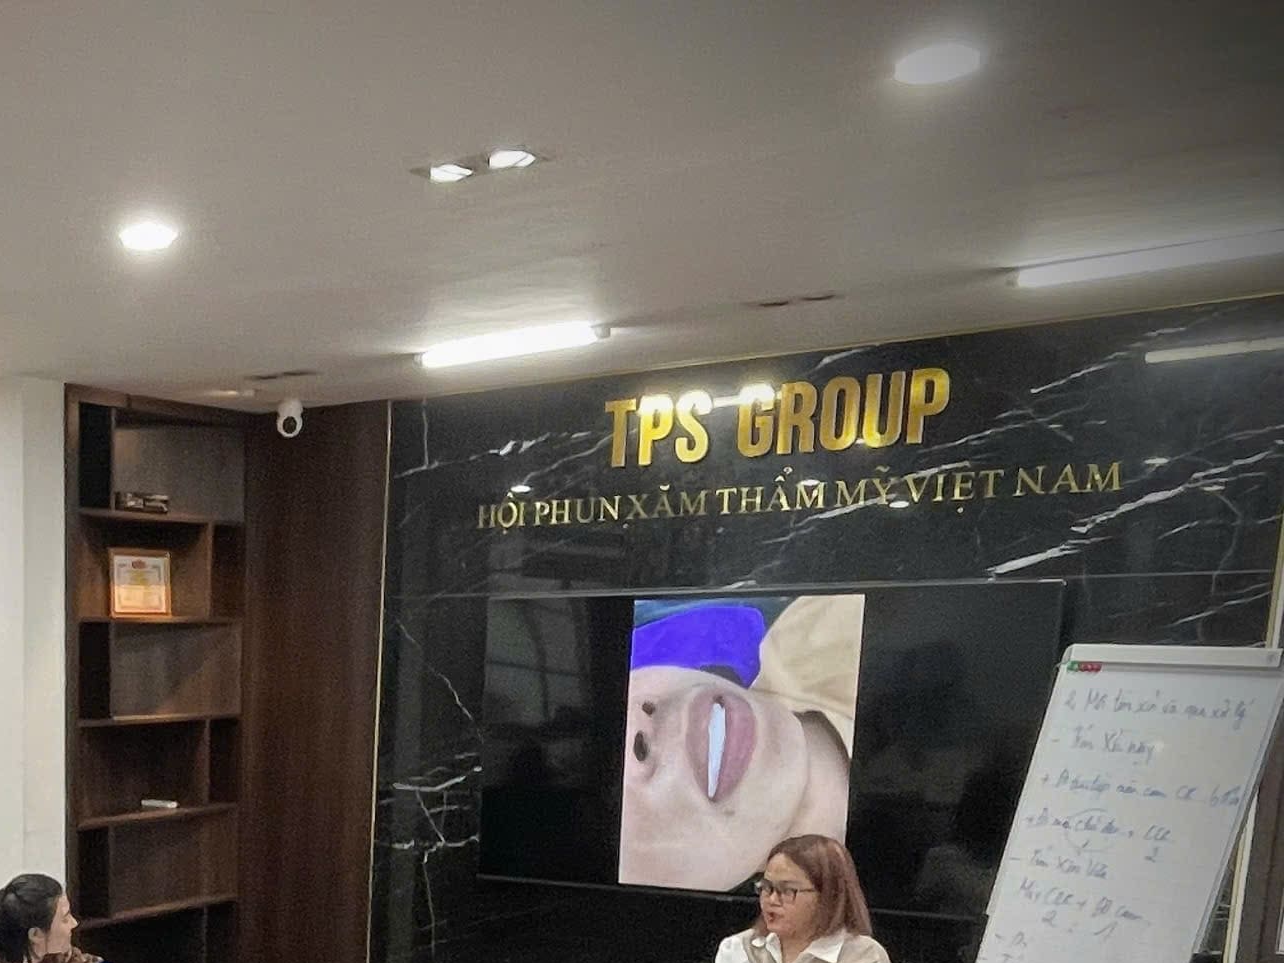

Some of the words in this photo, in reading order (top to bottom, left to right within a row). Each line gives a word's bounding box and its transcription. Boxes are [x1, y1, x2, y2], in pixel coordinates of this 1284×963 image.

[605, 389, 713, 468] TPS
[737, 368, 950, 458] GROUP
[477, 491, 525, 534] HỘI
[533, 495, 621, 527] PHUN
[626, 484, 707, 520] XĂM
[716, 466, 828, 512] THẨM
[835, 465, 898, 506] MỸ
[1012, 461, 1123, 497] NAM
